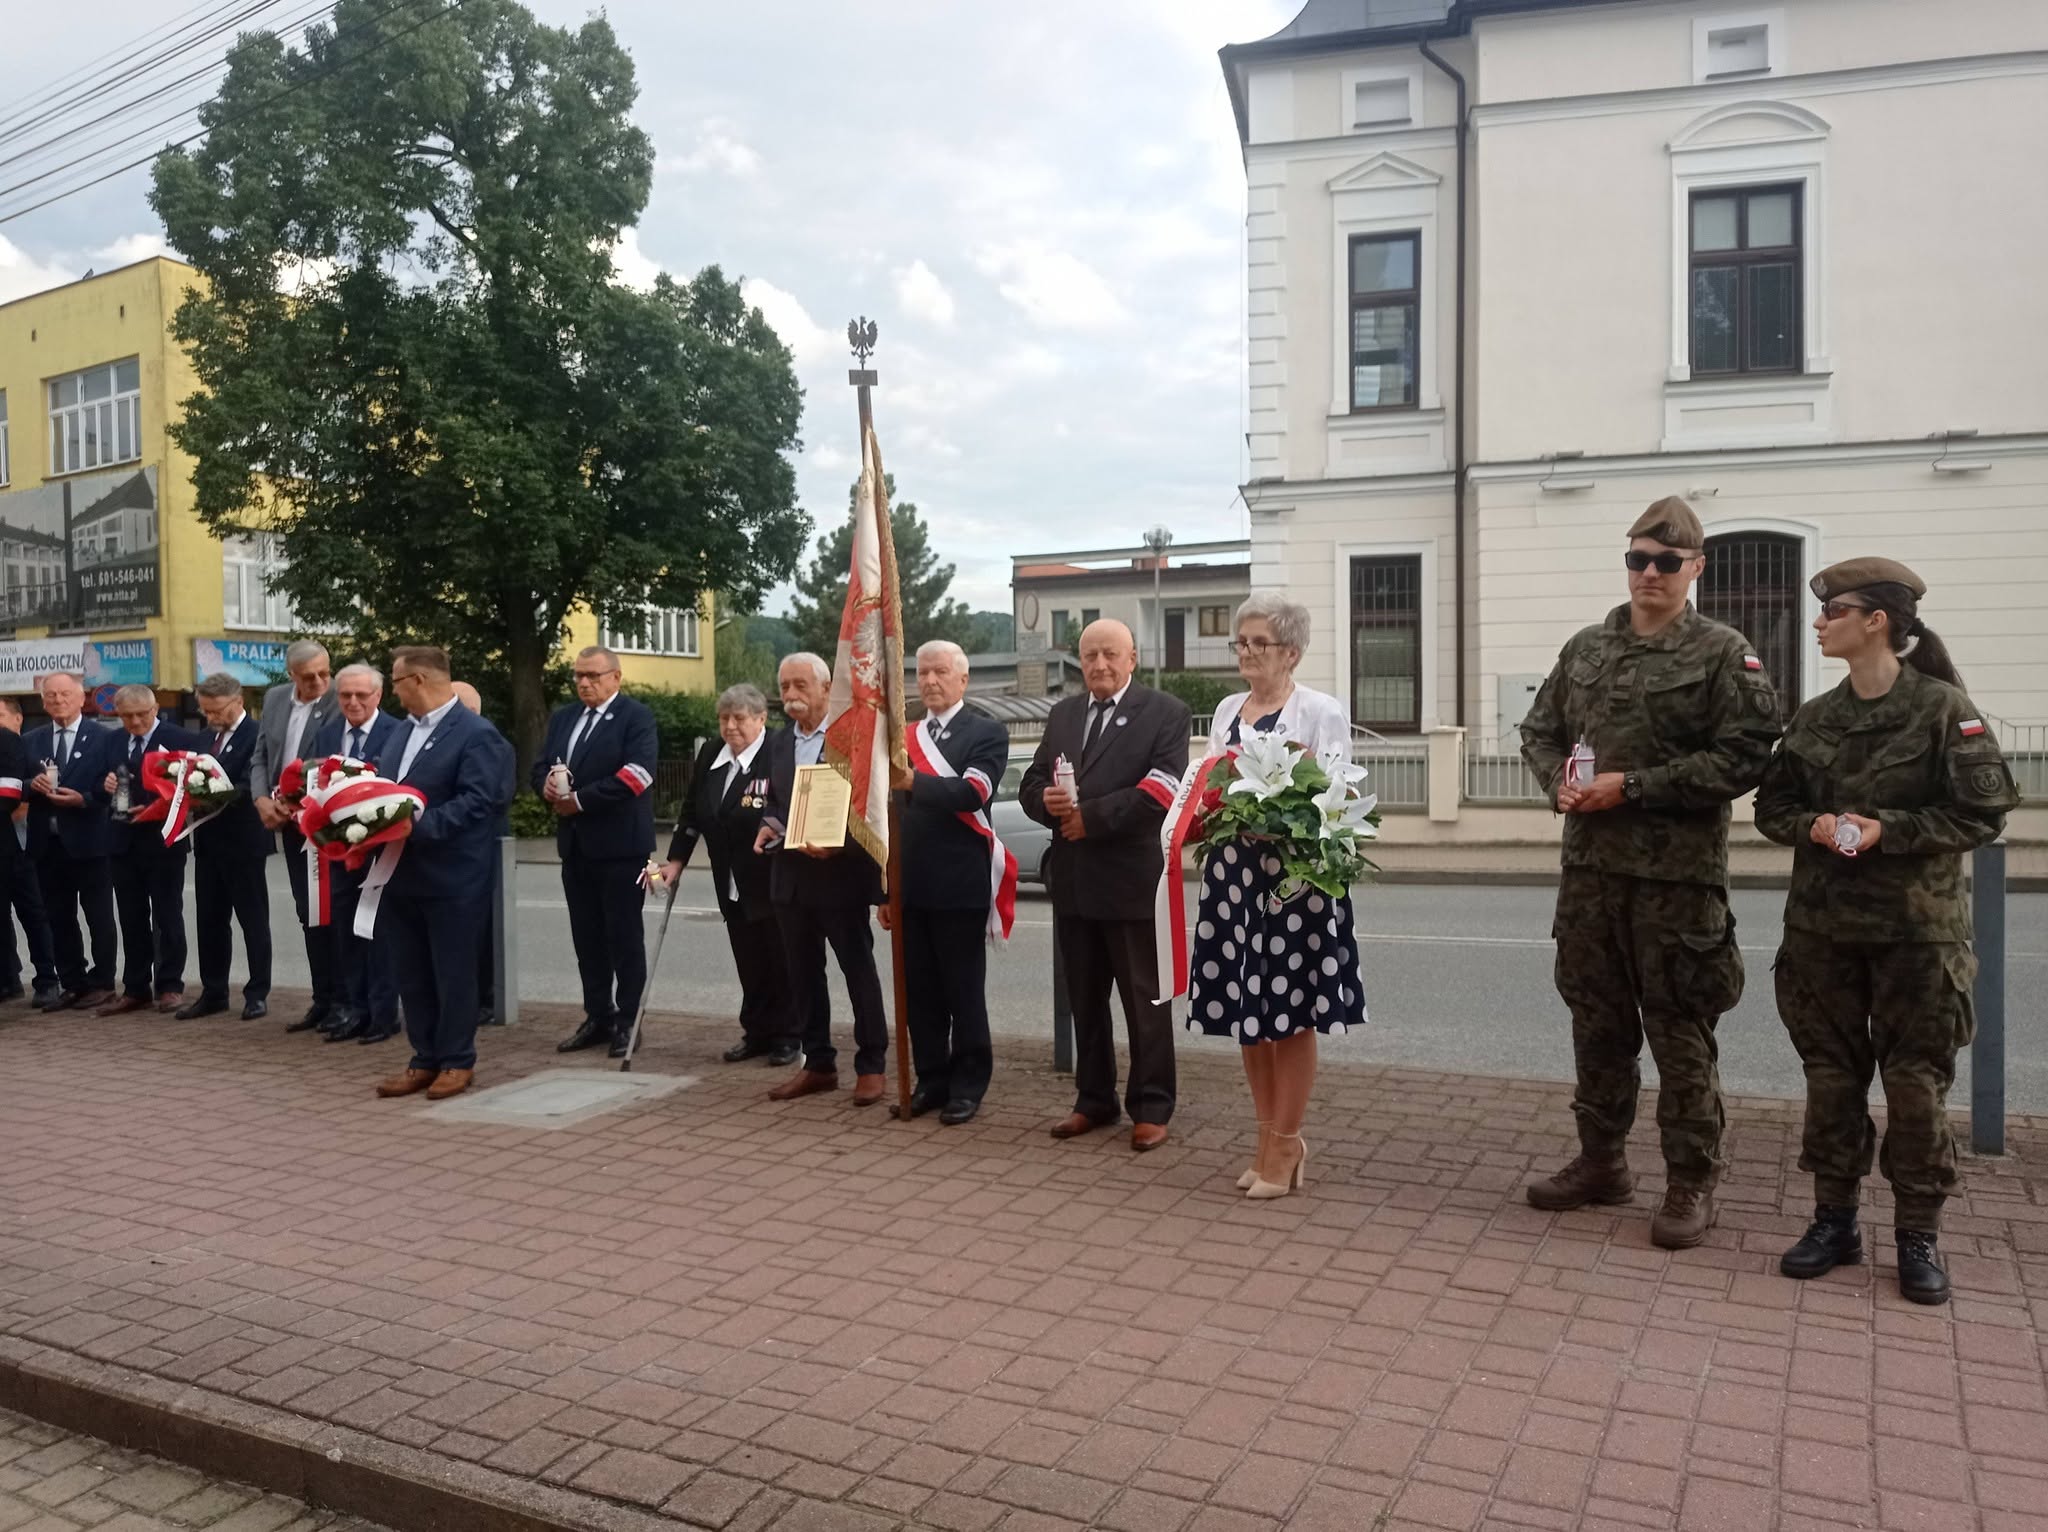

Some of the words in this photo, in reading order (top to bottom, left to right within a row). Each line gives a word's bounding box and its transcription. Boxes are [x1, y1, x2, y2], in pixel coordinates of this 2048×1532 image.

[81, 573, 96, 589] tel.
[98, 567, 155, 586] 601-546-041
[103, 643, 148, 659] PRALNIA
[16, 653, 86, 672] EKOLOGICZNA
